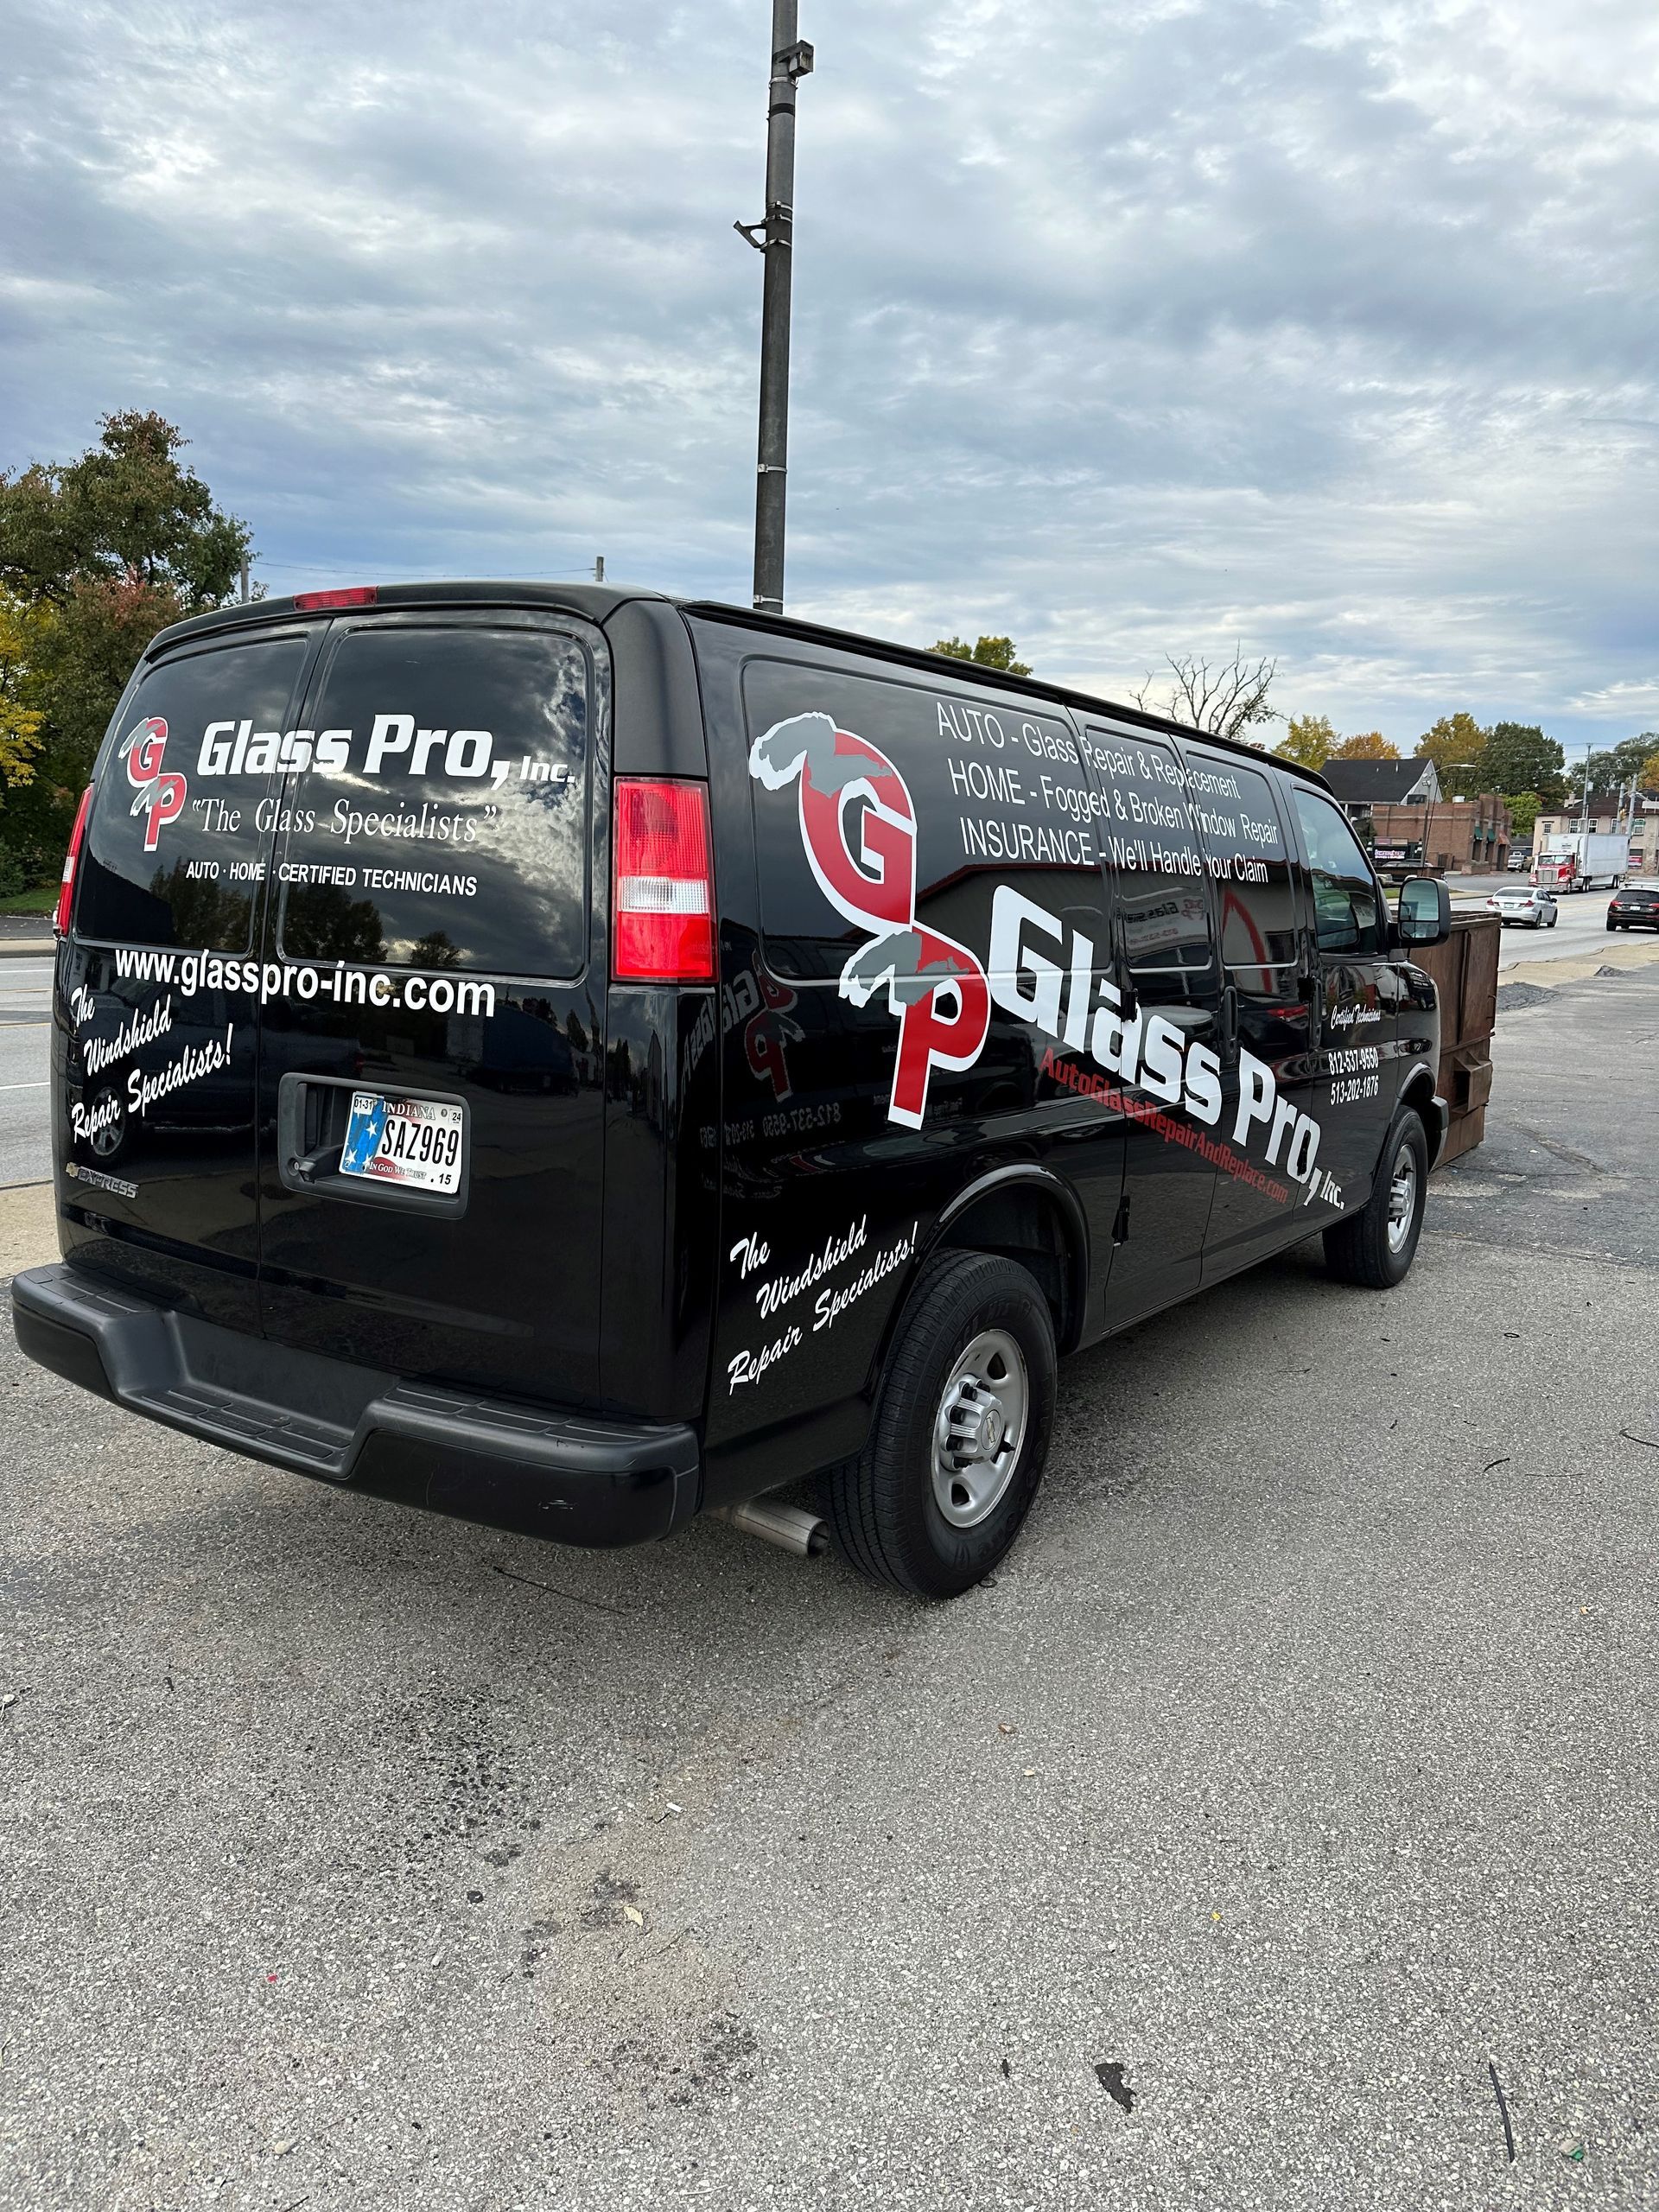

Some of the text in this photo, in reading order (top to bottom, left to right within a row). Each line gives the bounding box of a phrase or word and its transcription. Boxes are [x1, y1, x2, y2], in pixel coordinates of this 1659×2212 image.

[196, 714, 576, 791] Glass Pro, Inc.
[937, 702, 1005, 749] AUTO
[1022, 722, 1079, 766] Glass
[1080, 735, 1135, 780] Repair
[1136, 751, 1153, 779] &
[1150, 753, 1242, 800] Replacement
[255, 798, 315, 834] Glass
[948, 758, 1026, 806] HOME
[1040, 776, 1112, 824] Fogged
[1113, 793, 1128, 822] &
[1130, 792, 1185, 830] Broken
[1183, 801, 1236, 838] Window
[1240, 813, 1279, 849] Repair
[959, 817, 1095, 867] INSURANCE
[1109, 836, 1149, 873] We'll
[1150, 841, 1202, 877] Handle
[1203, 847, 1232, 880] Your
[1234, 852, 1269, 883] Claim
[186, 861, 219, 880] AUTO
[229, 862, 265, 881] HOME
[278, 864, 356, 887] CERTIFIED
[362, 868, 478, 896] TECHNICIANS
[71, 983, 95, 1027] The
[115, 949, 496, 1017] www.glasspro-inc.com
[84, 994, 172, 1077] Windshield
[988, 884, 1220, 1126] Glass
[1232, 1046, 1322, 1206] Pro,
[1319, 1171, 1345, 1210] Inc.
[71, 1022, 233, 1145] Repair Specialists!
[1328, 1046, 1378, 1076] 812-537-9550
[354, 1098, 373, 1109] 01-31
[382, 1101, 435, 1121] INDIANA
[1331, 1075, 1379, 1105] 513-202-1876
[452, 1112, 461, 1122] 24
[1039, 1046, 1289, 1204] AutoGlassRepairAndReplace.com
[381, 1119, 460, 1166] SAZ969
[78, 1166, 138, 1198] EXPRESS
[369, 1161, 376, 1170] IN
[378, 1163, 393, 1173] GOD
[405, 1167, 427, 1180] TRUST
[439, 1173, 452, 1185] 15
[729, 1231, 771, 1281] The
[756, 1214, 868, 1320] Windshield
[728, 1221, 918, 1396] Repair Specialists!
